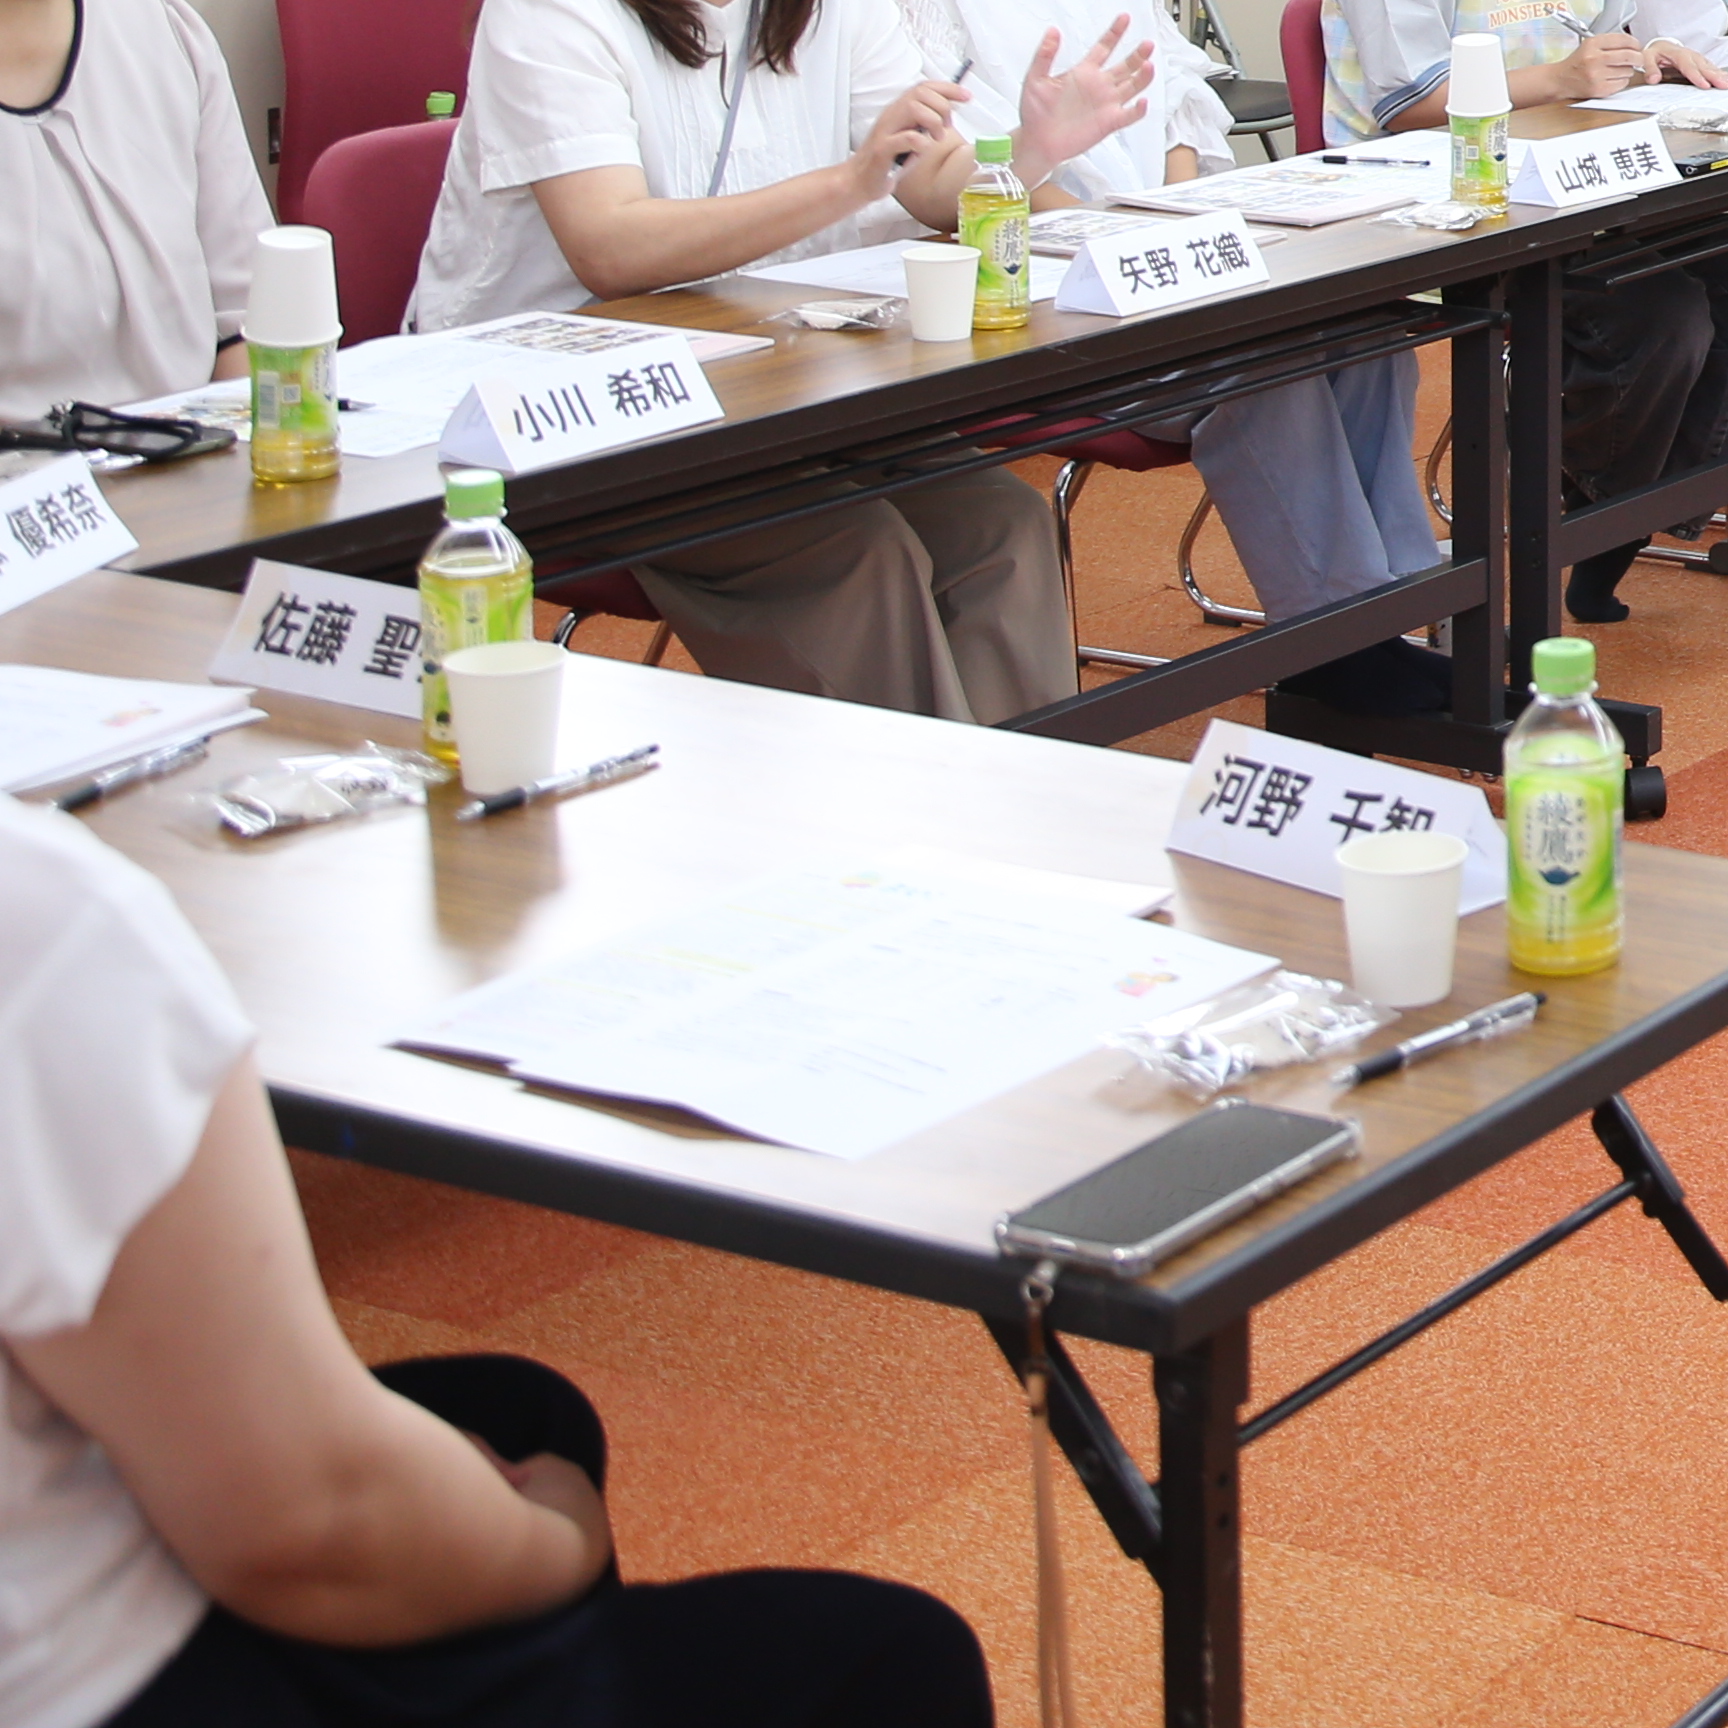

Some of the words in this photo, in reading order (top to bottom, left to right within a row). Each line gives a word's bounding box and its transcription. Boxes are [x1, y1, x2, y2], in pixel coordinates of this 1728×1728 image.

[1488, 1, 1567, 29] MONSTERS
[1555, 152, 1608, 194] 山城
[1609, 141, 1664, 181] 恵美
[1118, 247, 1179, 295] 矢野
[1186, 231, 1250, 279] 花織
[512, 383, 597, 442] 小川
[606, 361, 692, 417] 希和
[5, 482, 108, 559] 優希奈
[254, 590, 358, 666] 佐藤
[363, 614, 423, 684] 聖
[1199, 753, 1314, 837] 河野
